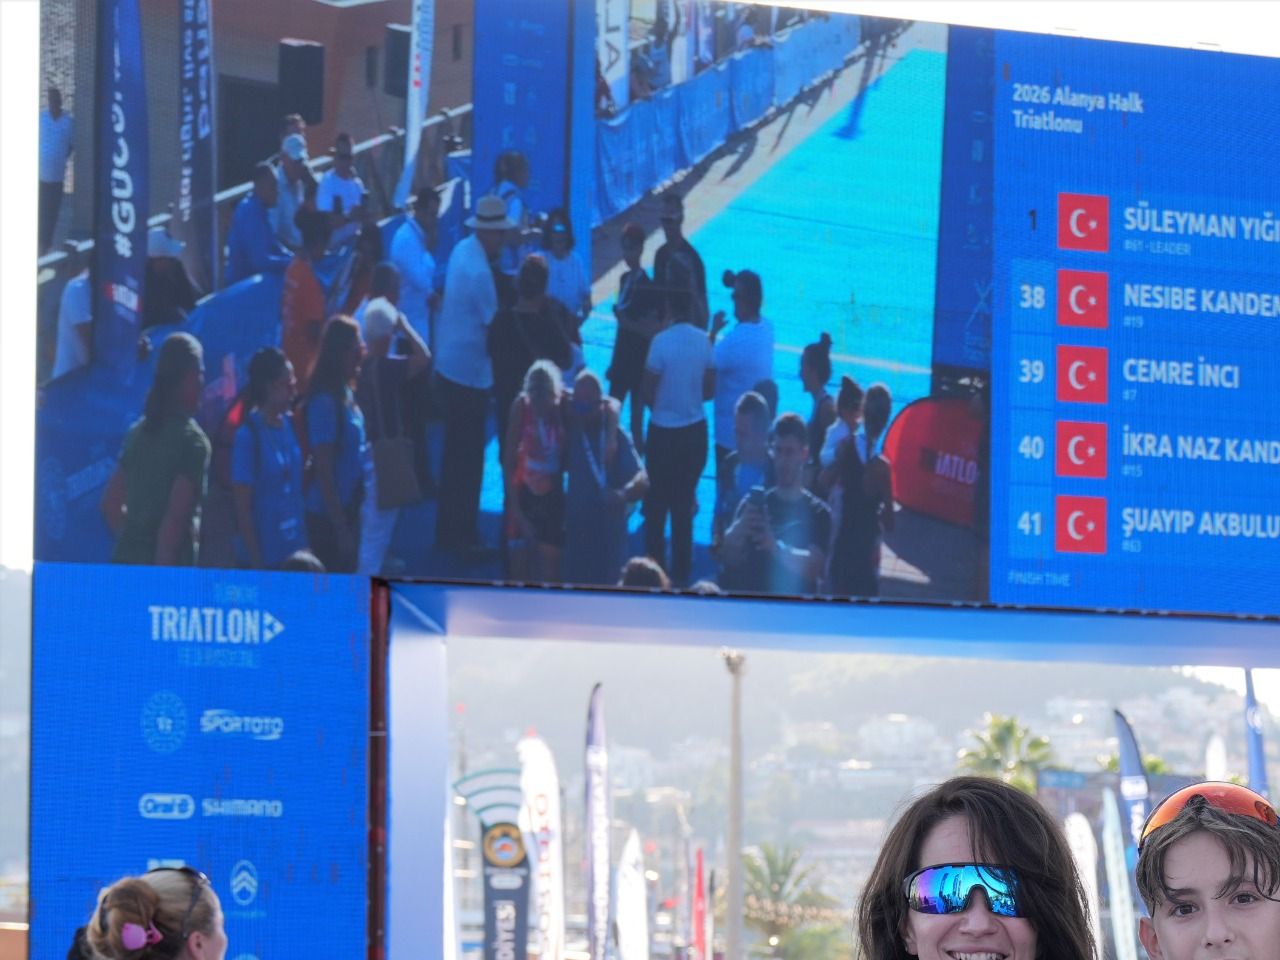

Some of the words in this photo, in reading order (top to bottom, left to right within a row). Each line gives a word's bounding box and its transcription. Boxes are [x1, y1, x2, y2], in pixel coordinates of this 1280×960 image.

[1013, 83, 1051, 104] 2026
[1053, 87, 1105, 112] Alanya
[1108, 93, 1143, 113] Halk
[1013, 110, 1084, 134] Triatlonu
[1028, 209, 1038, 231] 1
[1124, 201, 1239, 240] SÜLEYMAN
[1019, 285, 1045, 309] 38
[1123, 284, 1197, 311] NESIBE
[1018, 359, 1045, 384] 39
[1122, 358, 1195, 386] CEMRE
[1018, 435, 1044, 460] 40
[1122, 424, 1174, 459] İKRA
[1176, 435, 1222, 461] NAZ
[1017, 511, 1043, 536] 41
[201, 798, 284, 818] SHIMANO
